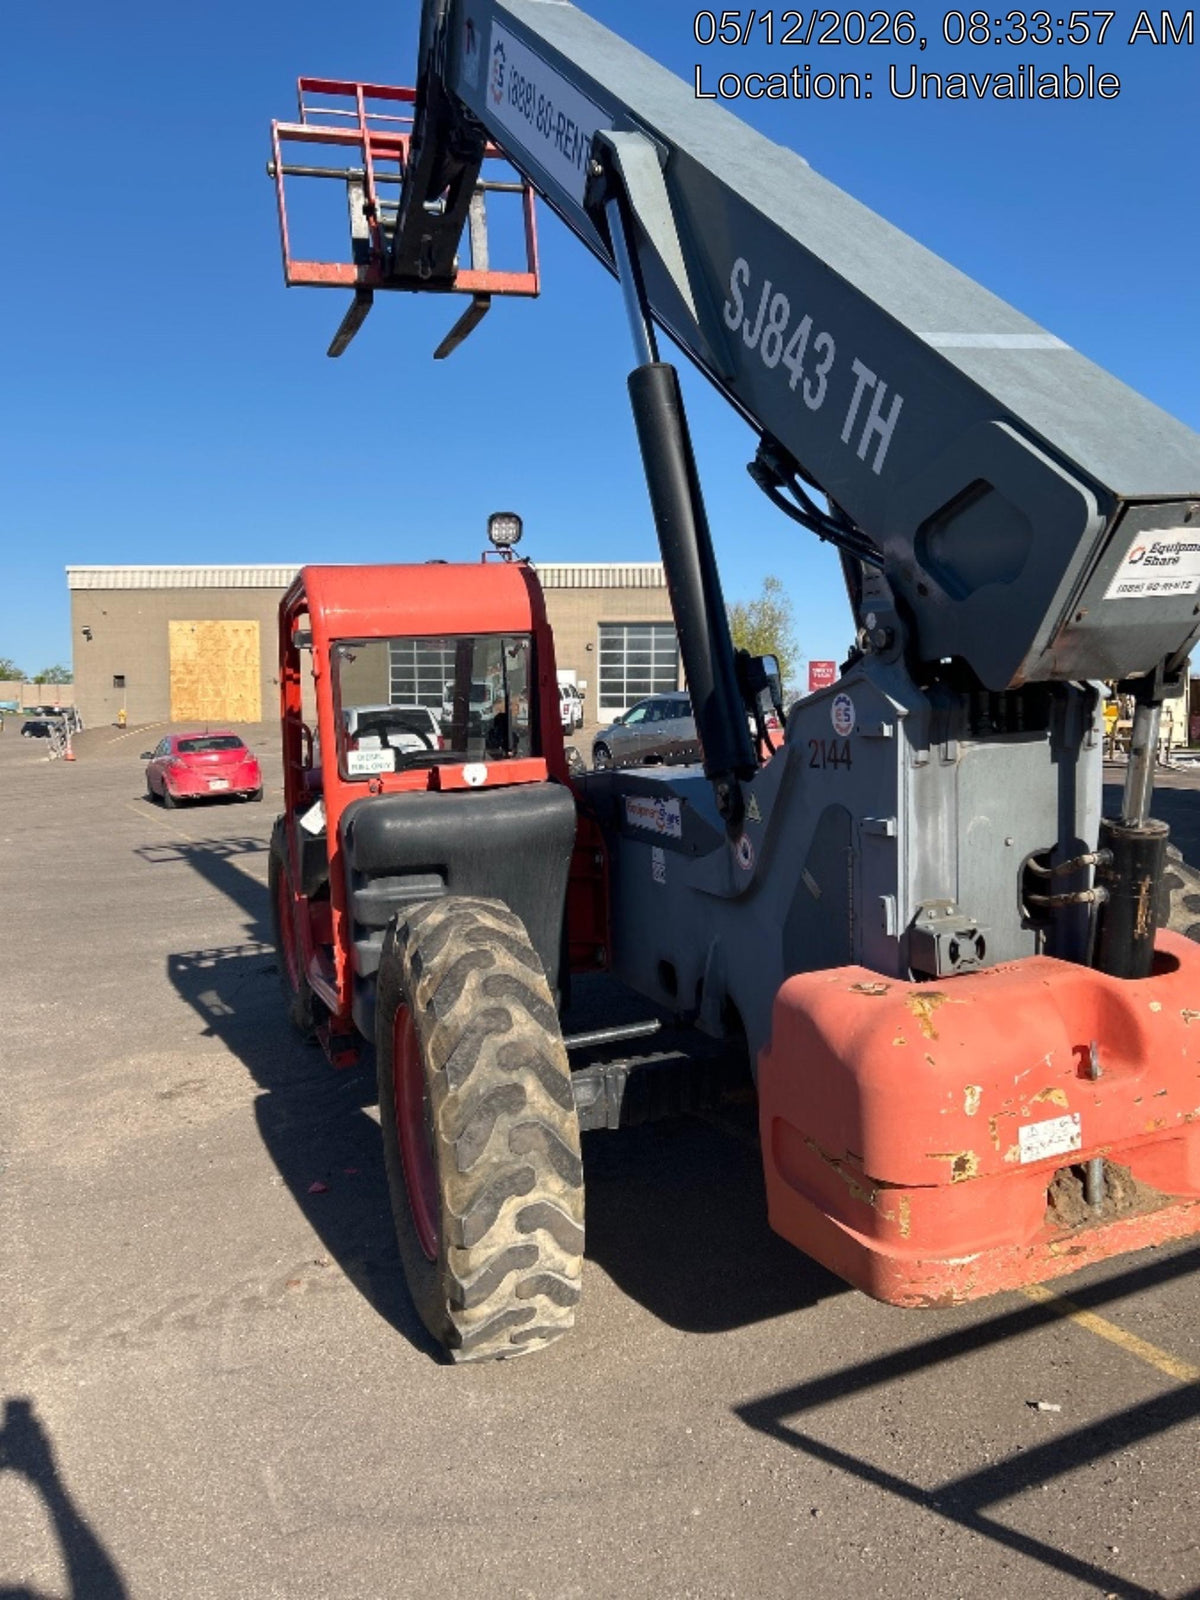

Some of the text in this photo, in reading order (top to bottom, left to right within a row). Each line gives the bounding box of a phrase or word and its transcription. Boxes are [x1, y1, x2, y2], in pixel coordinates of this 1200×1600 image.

[723, 256, 904, 476] SJ843 TH
[1142, 555, 1180, 566] Share
[808, 738, 853, 772] 2144
